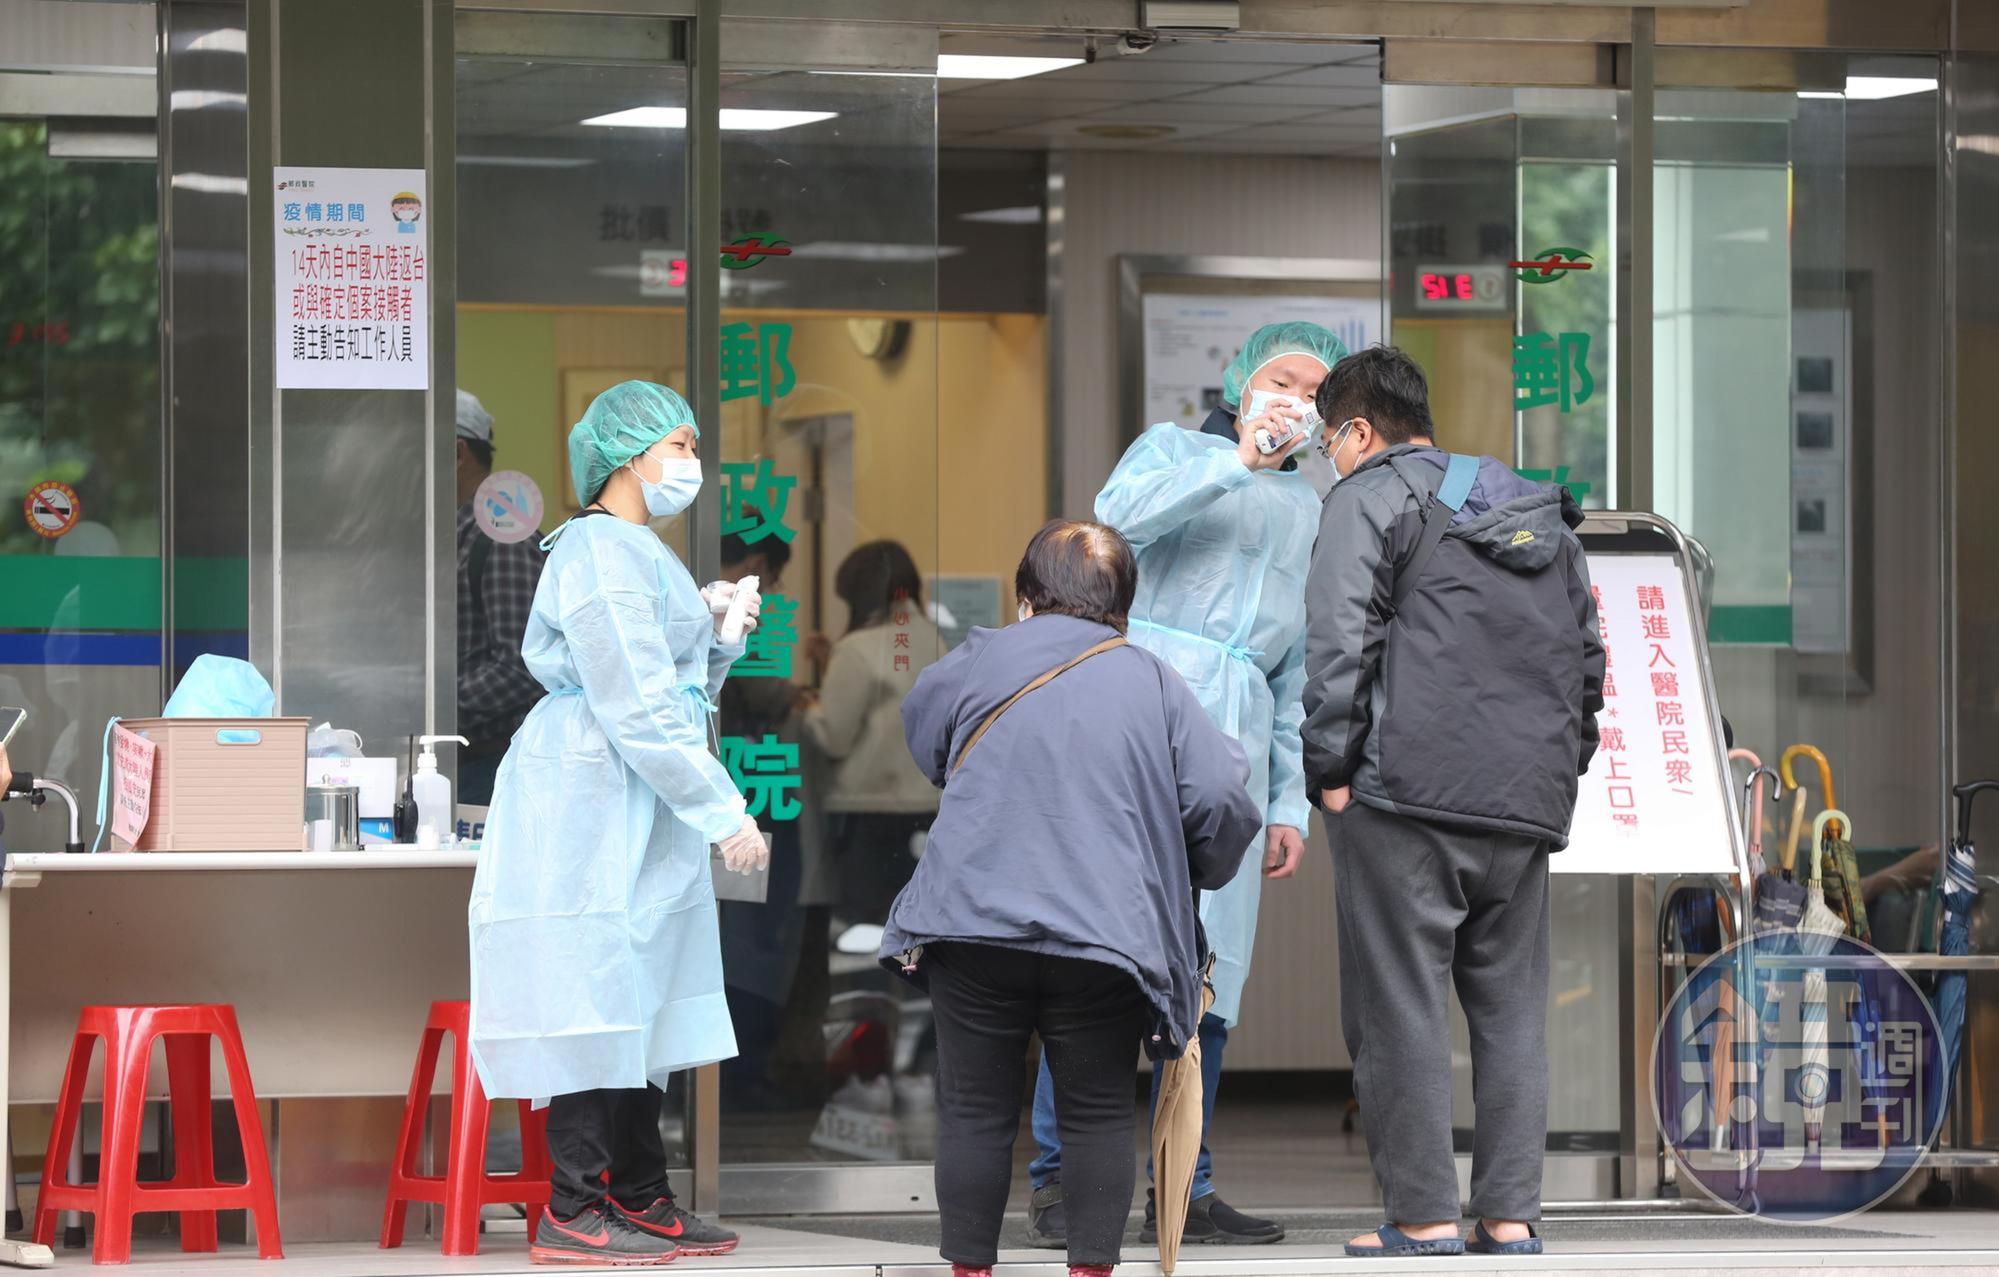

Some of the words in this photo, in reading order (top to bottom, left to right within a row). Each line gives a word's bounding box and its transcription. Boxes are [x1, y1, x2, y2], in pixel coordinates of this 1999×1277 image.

[284, 203, 365, 222] 疫情期間
[291, 244, 424, 282] 14天內自中國大陸返台
[293, 283, 412, 322] 或與確定個案接觸者
[293, 324, 413, 362] 請主動告知工作人員
[719, 321, 803, 823] 郵政醫院
